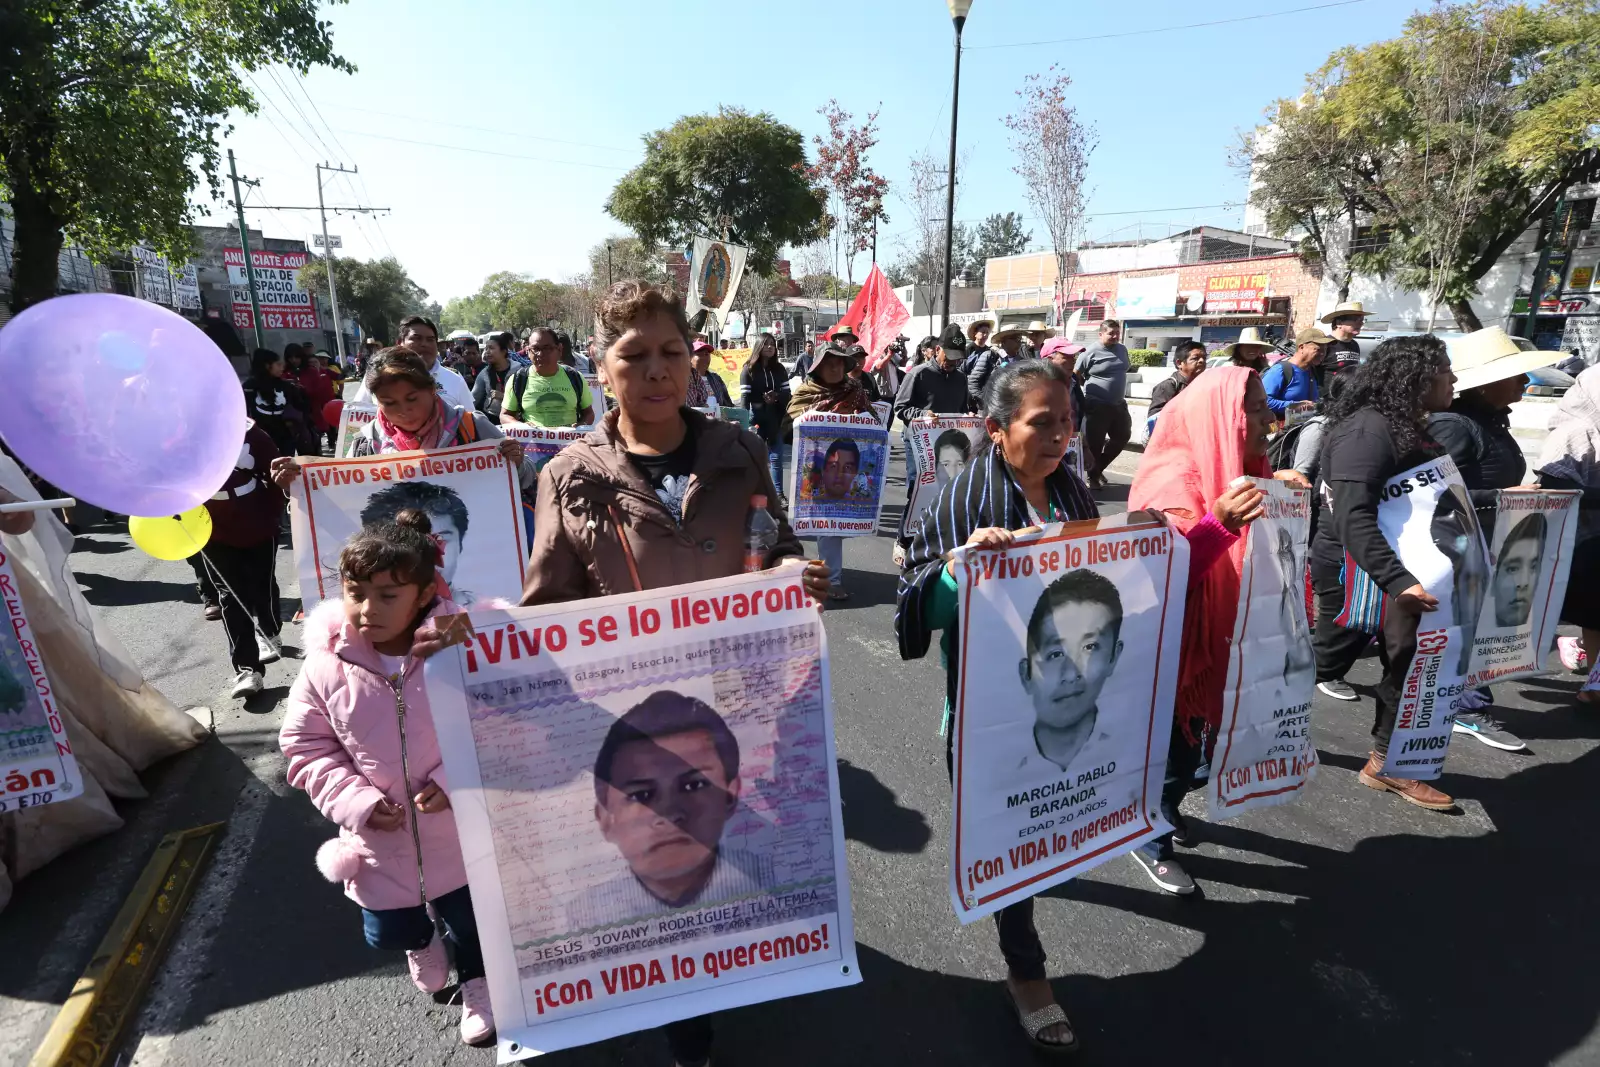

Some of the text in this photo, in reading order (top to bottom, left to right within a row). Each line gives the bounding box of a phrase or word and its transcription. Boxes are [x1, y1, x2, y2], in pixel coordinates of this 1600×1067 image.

[224, 252, 281, 266] ANUCIATE
[240, 268, 293, 281] RNTA DE
[1209, 275, 1241, 290] CLUTCH
[1243, 275, 1250, 288] Y
[254, 280, 293, 292] SPACIO
[234, 290, 308, 303] PULICITARIO
[234, 312, 315, 328] 55 162 1125
[951, 315, 976, 323] RENTA
[349, 411, 377, 423] ¡Viv
[827, 415, 837, 423] se
[839, 415, 848, 423] lo
[939, 421, 946, 429] se
[948, 420, 955, 429] lo
[531, 430, 544, 439] se
[546, 430, 556, 440] lo
[922, 433, 931, 449] Nos
[311, 453, 503, 490] ¡Vivo se lo llevaron!
[1416, 468, 1438, 487] SE
[812, 520, 829, 529] VIDA
[831, 520, 837, 529] lo
[838, 521, 873, 531] queremos!
[973, 531, 1167, 587] ¡Vivo se lo llevaron!
[464, 584, 812, 673] ¡Vivo se lo llevaron!
[502, 686, 523, 696] Jan
[575, 665, 625, 682] Glasgow,
[685, 646, 721, 661] quiero
[726, 641, 754, 654] saber
[1398, 628, 1448, 729] Nos faltan 43!
[1417, 655, 1442, 729] Dónde están
[8, 734, 46, 750] CRUZ
[1401, 735, 1447, 754] ¡VIVOS
[0, 769, 56, 793] án
[1007, 761, 1116, 808] MARCIAL PABLO
[1226, 767, 1251, 794] ¡Con
[1255, 758, 1287, 781] VIDA
[1030, 786, 1097, 818] BARANDA
[1018, 798, 1108, 838] EDAD 20 AÑOS
[968, 798, 1138, 891] ¡Con VIDA lo queremos!
[534, 888, 819, 961] JESÚS JOVANY RODRÍGUEZ TLATEMPA
[534, 923, 829, 1015] ¡Con VIDA lo queremos!
